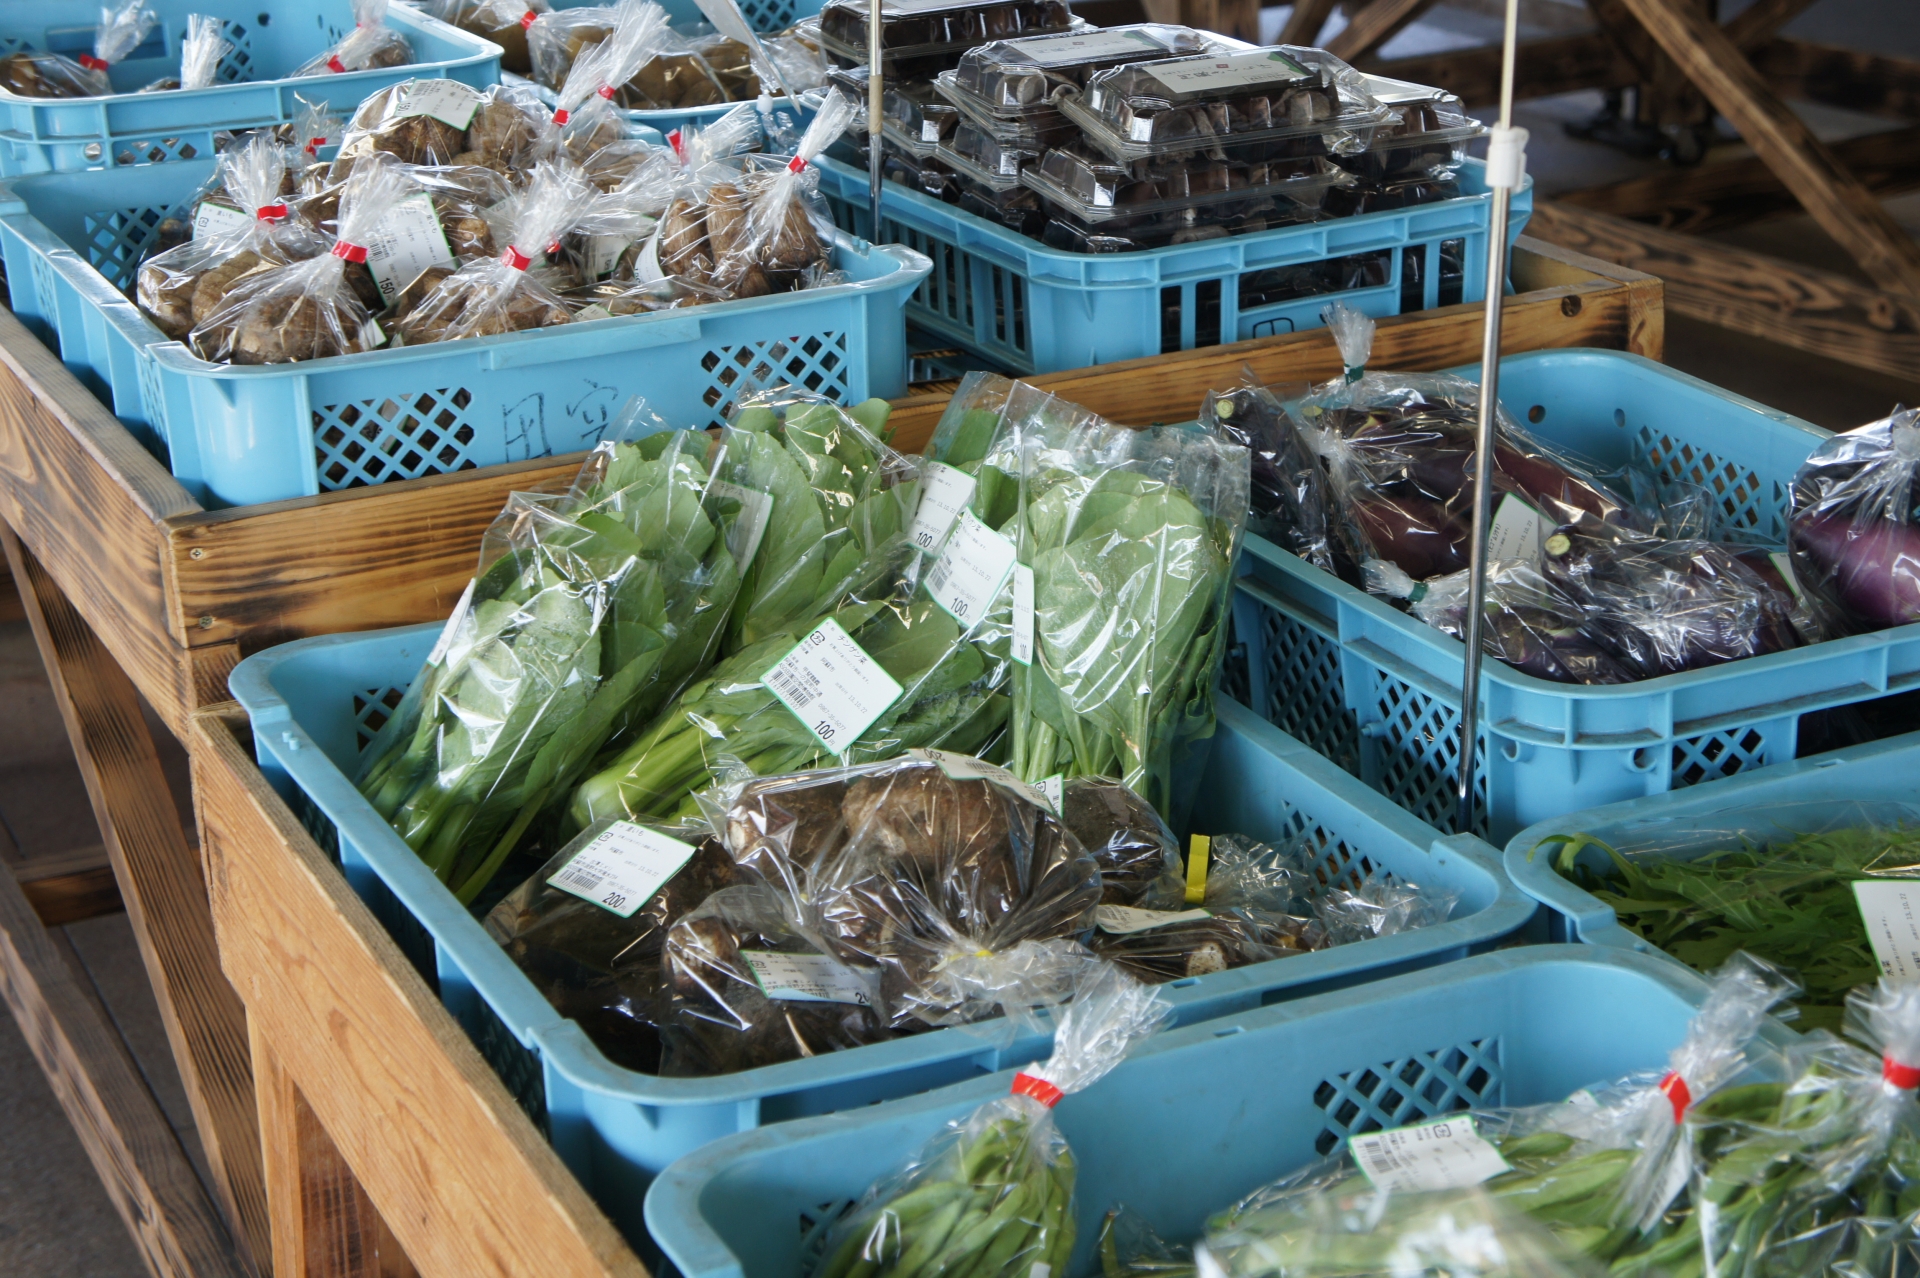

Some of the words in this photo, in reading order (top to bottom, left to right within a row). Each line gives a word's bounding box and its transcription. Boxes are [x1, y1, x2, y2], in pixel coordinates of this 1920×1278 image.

[378, 277, 395, 295] 150
[916, 531, 933, 548] 100
[950, 597, 968, 617] 100
[837, 634, 868, 665] チンゲン菜
[847, 694, 868, 714] 13.10.22
[814, 720, 835, 740] 100
[923, 748, 945, 762] 200
[602, 891, 626, 908] 200
[1881, 960, 1894, 977] 水菜
[855, 992, 869, 1004] 2
